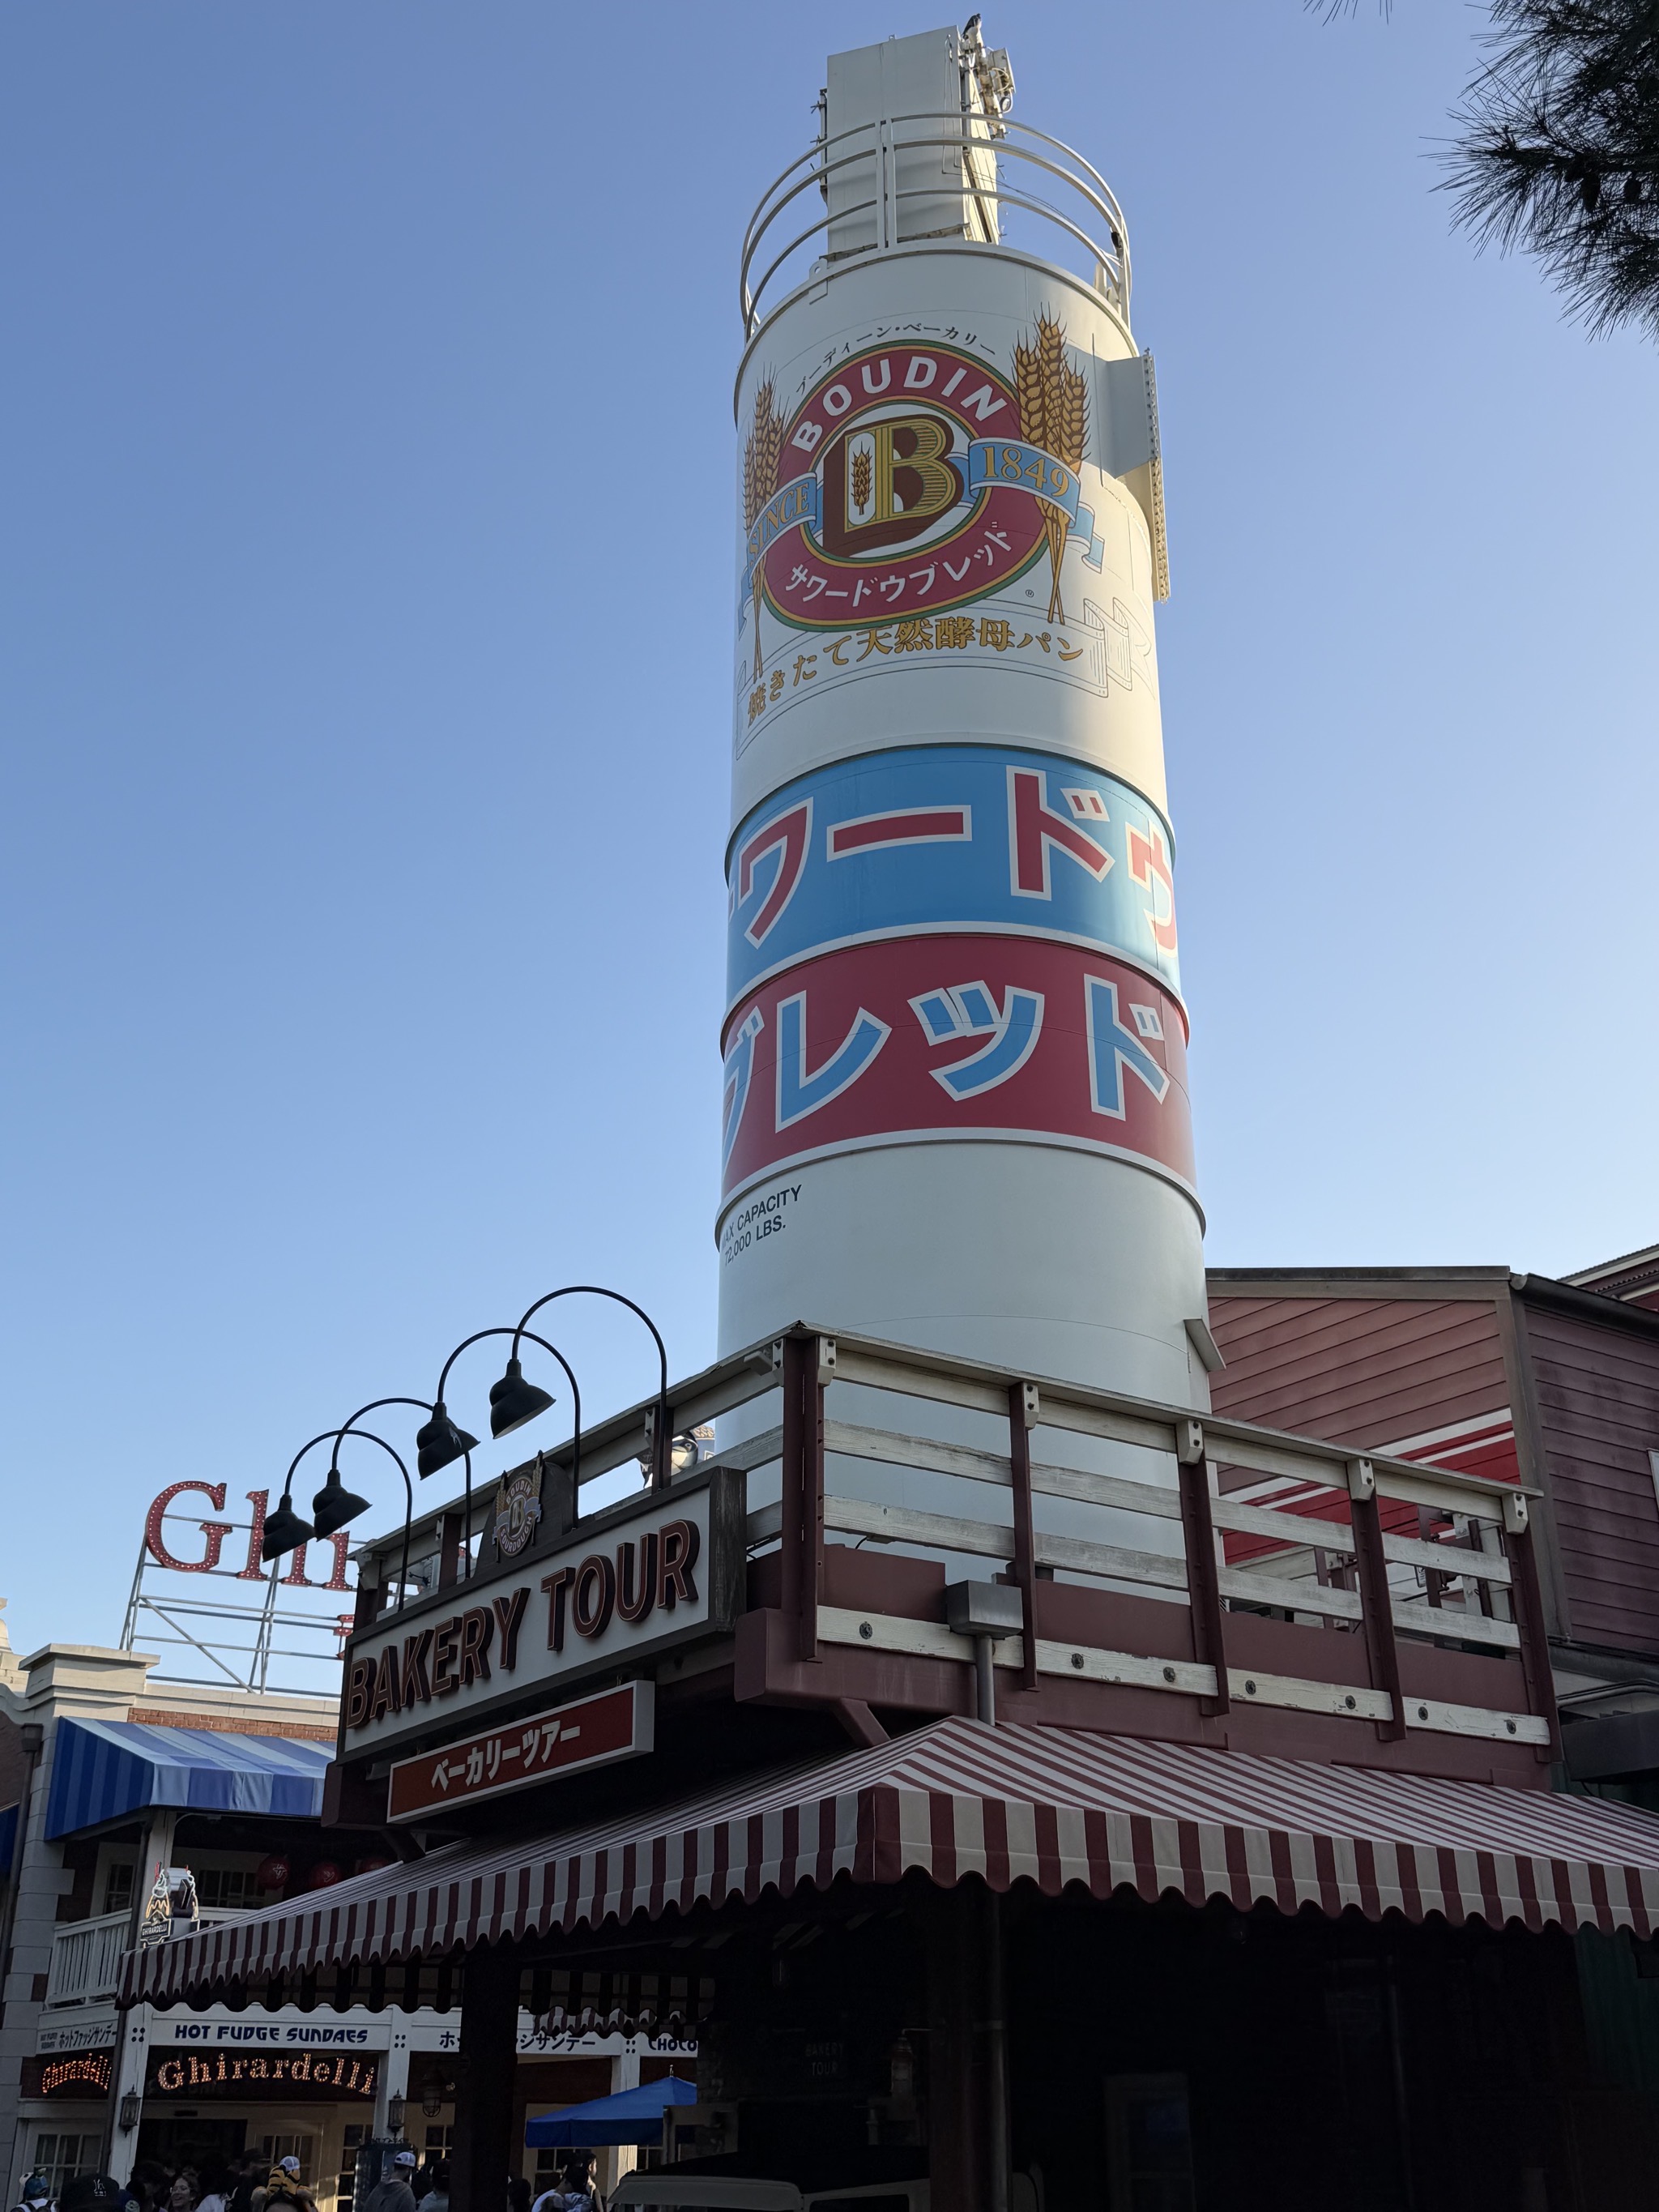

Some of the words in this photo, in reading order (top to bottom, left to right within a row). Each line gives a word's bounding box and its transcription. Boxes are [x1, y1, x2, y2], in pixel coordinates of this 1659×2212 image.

[791, 355, 1008, 453] BOUDIN
[748, 482, 809, 567] SINCE
[982, 446, 1069, 497] 1849
[785, 521, 1012, 607] サワードウブレッド
[748, 617, 1083, 728] 焼きたて天然酵母パン
[728, 766, 1178, 959] ワードウ
[737, 1185, 802, 1232] CAPACITY
[756, 1215, 787, 1241] LBS.
[506, 1480, 531, 1504] BOUDIN
[500, 1516, 532, 1552] SOURDOUGH
[346, 1587, 531, 1729] BAKERY
[540, 1519, 701, 1651] TOUR
[431, 1720, 582, 1791] ベーカリーツアー
[142, 1924, 168, 1936] GHIRARDELLI
[175, 2025, 211, 2039] HOT
[217, 2026, 279, 2041] FUDGE
[287, 2027, 368, 2043] SUNDAES
[42, 2052, 113, 2094] Ghirardelli
[157, 2052, 375, 2095] Ghirardelli
